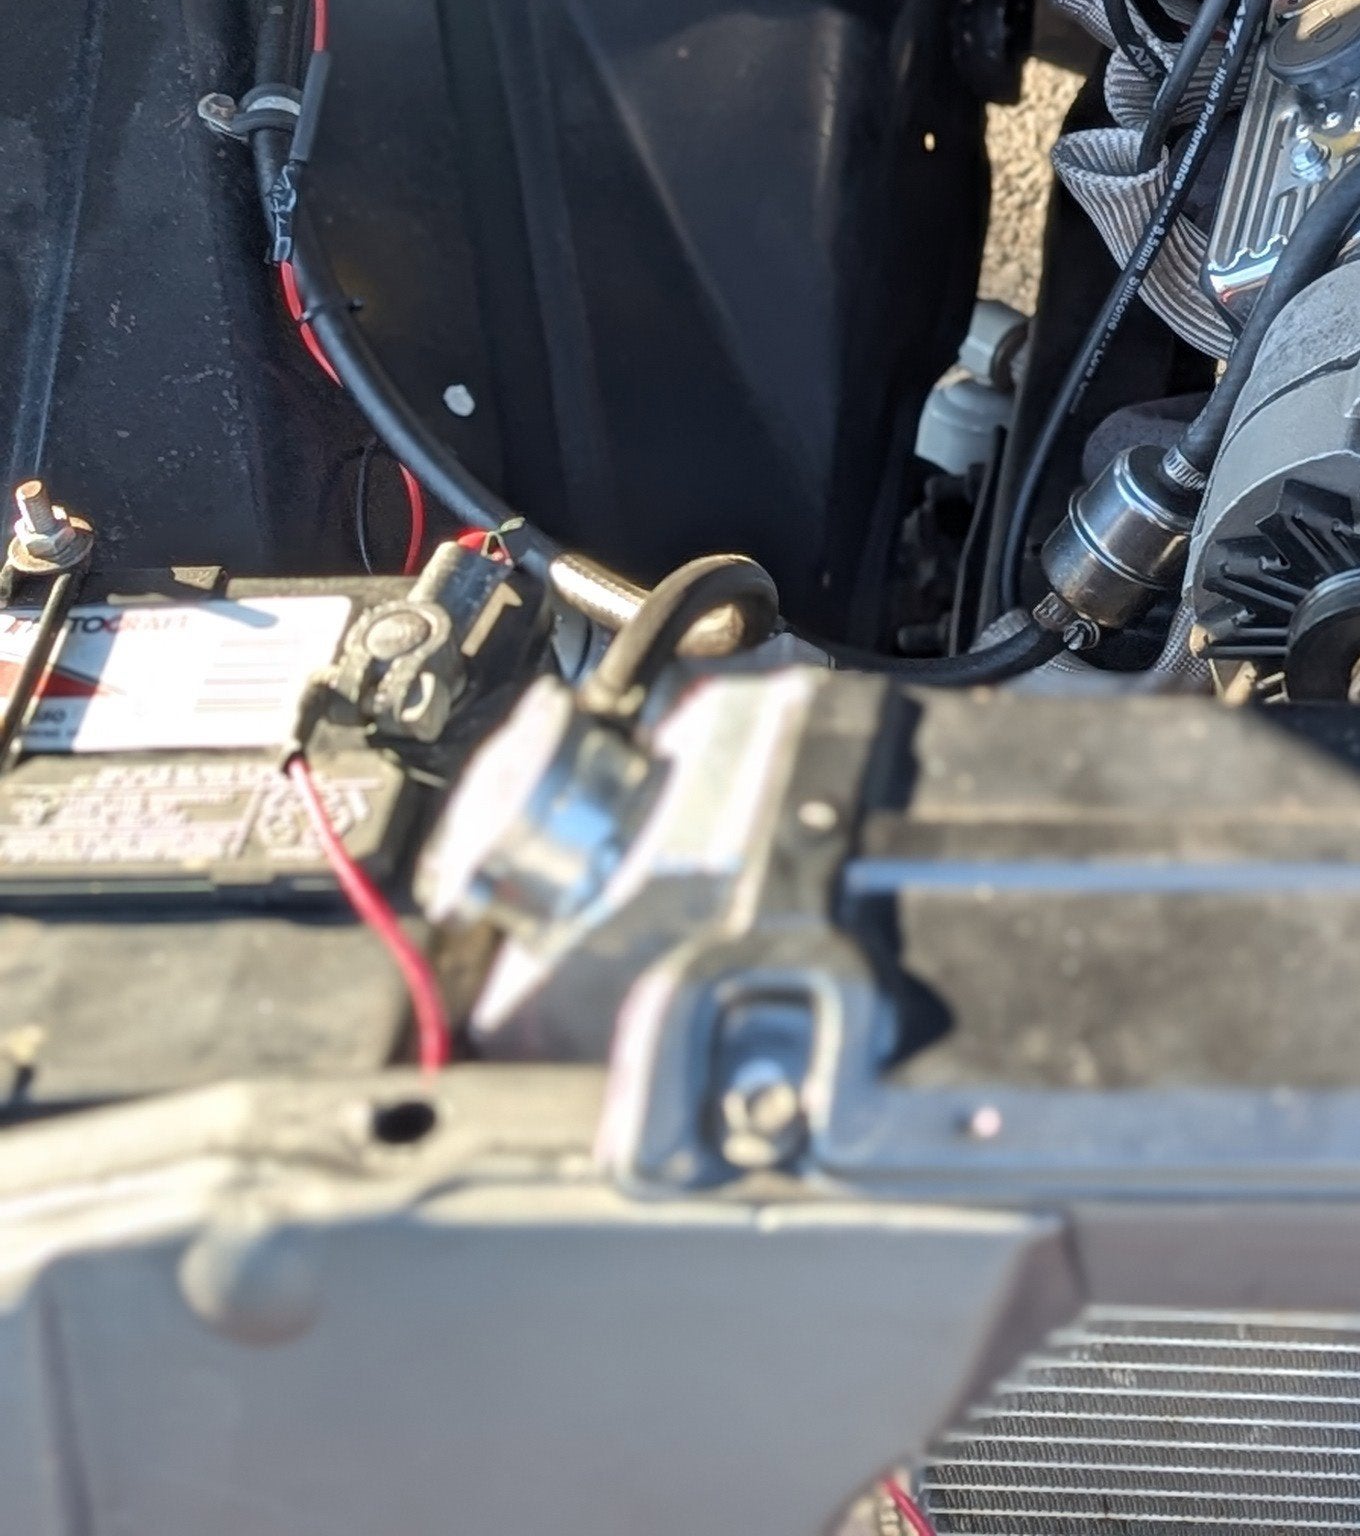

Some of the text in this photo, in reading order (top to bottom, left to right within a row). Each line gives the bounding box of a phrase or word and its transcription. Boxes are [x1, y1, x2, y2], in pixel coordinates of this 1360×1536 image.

[1126, 43, 1163, 78] ATK
[1172, 101, 1216, 192] Performance
[1135, 224, 1166, 272] 8.5mm
[1106, 275, 1142, 332] Silicone
